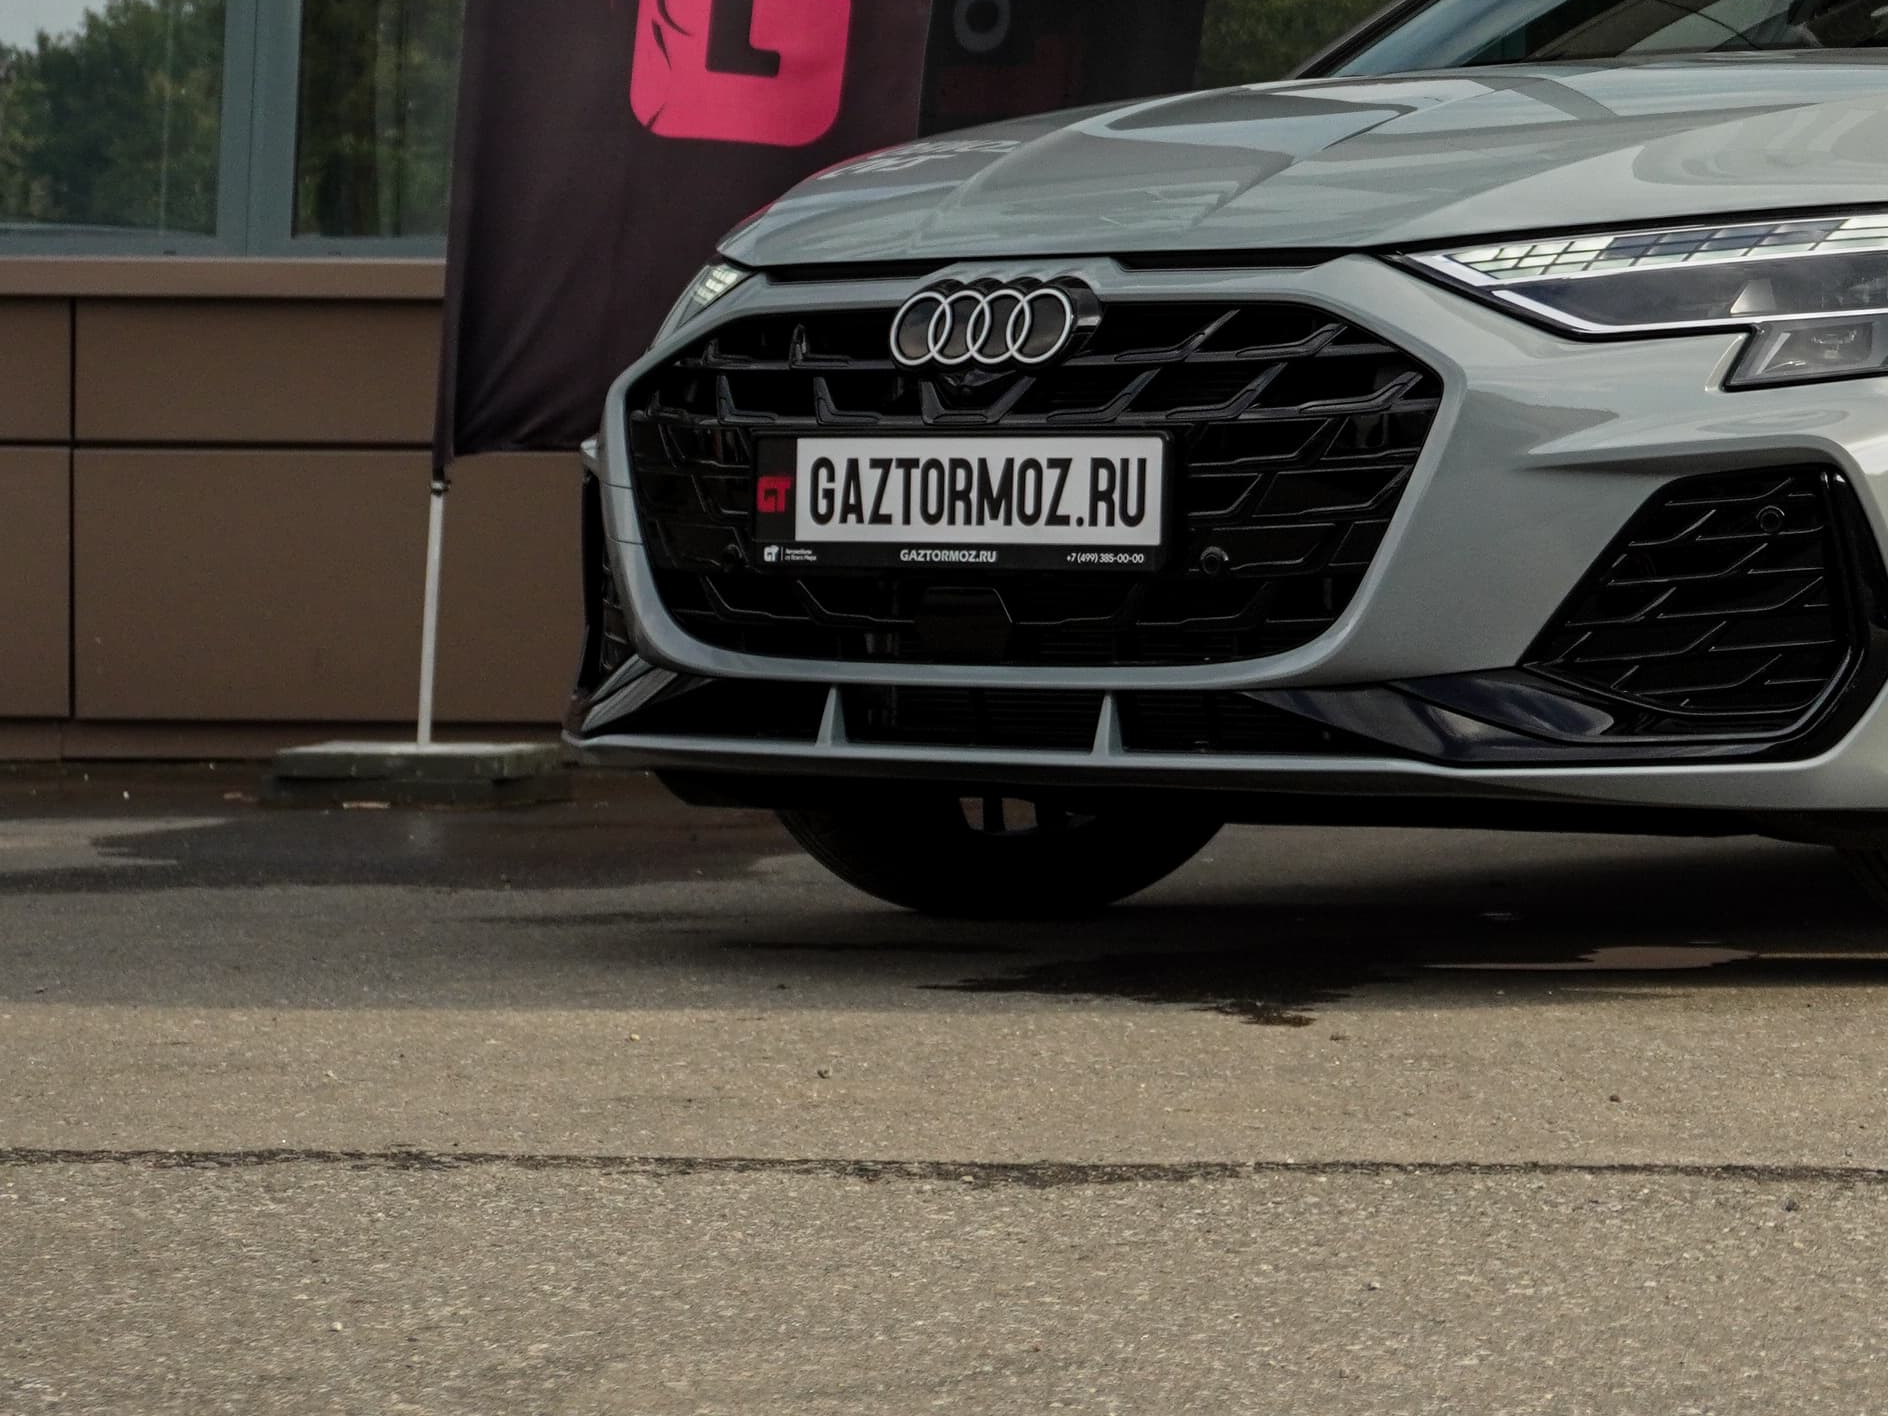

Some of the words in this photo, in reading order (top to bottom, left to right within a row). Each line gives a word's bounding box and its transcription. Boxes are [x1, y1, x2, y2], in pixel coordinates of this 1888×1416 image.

[757, 475, 790, 513] GT
[810, 457, 1147, 528] GAZTORMOZ.RU
[900, 549, 997, 564] GAZTORMOZ.RU
[1066, 553, 1076, 562] +7
[1077, 552, 1098, 564] (499)
[1099, 553, 1145, 563] 385-00-00
